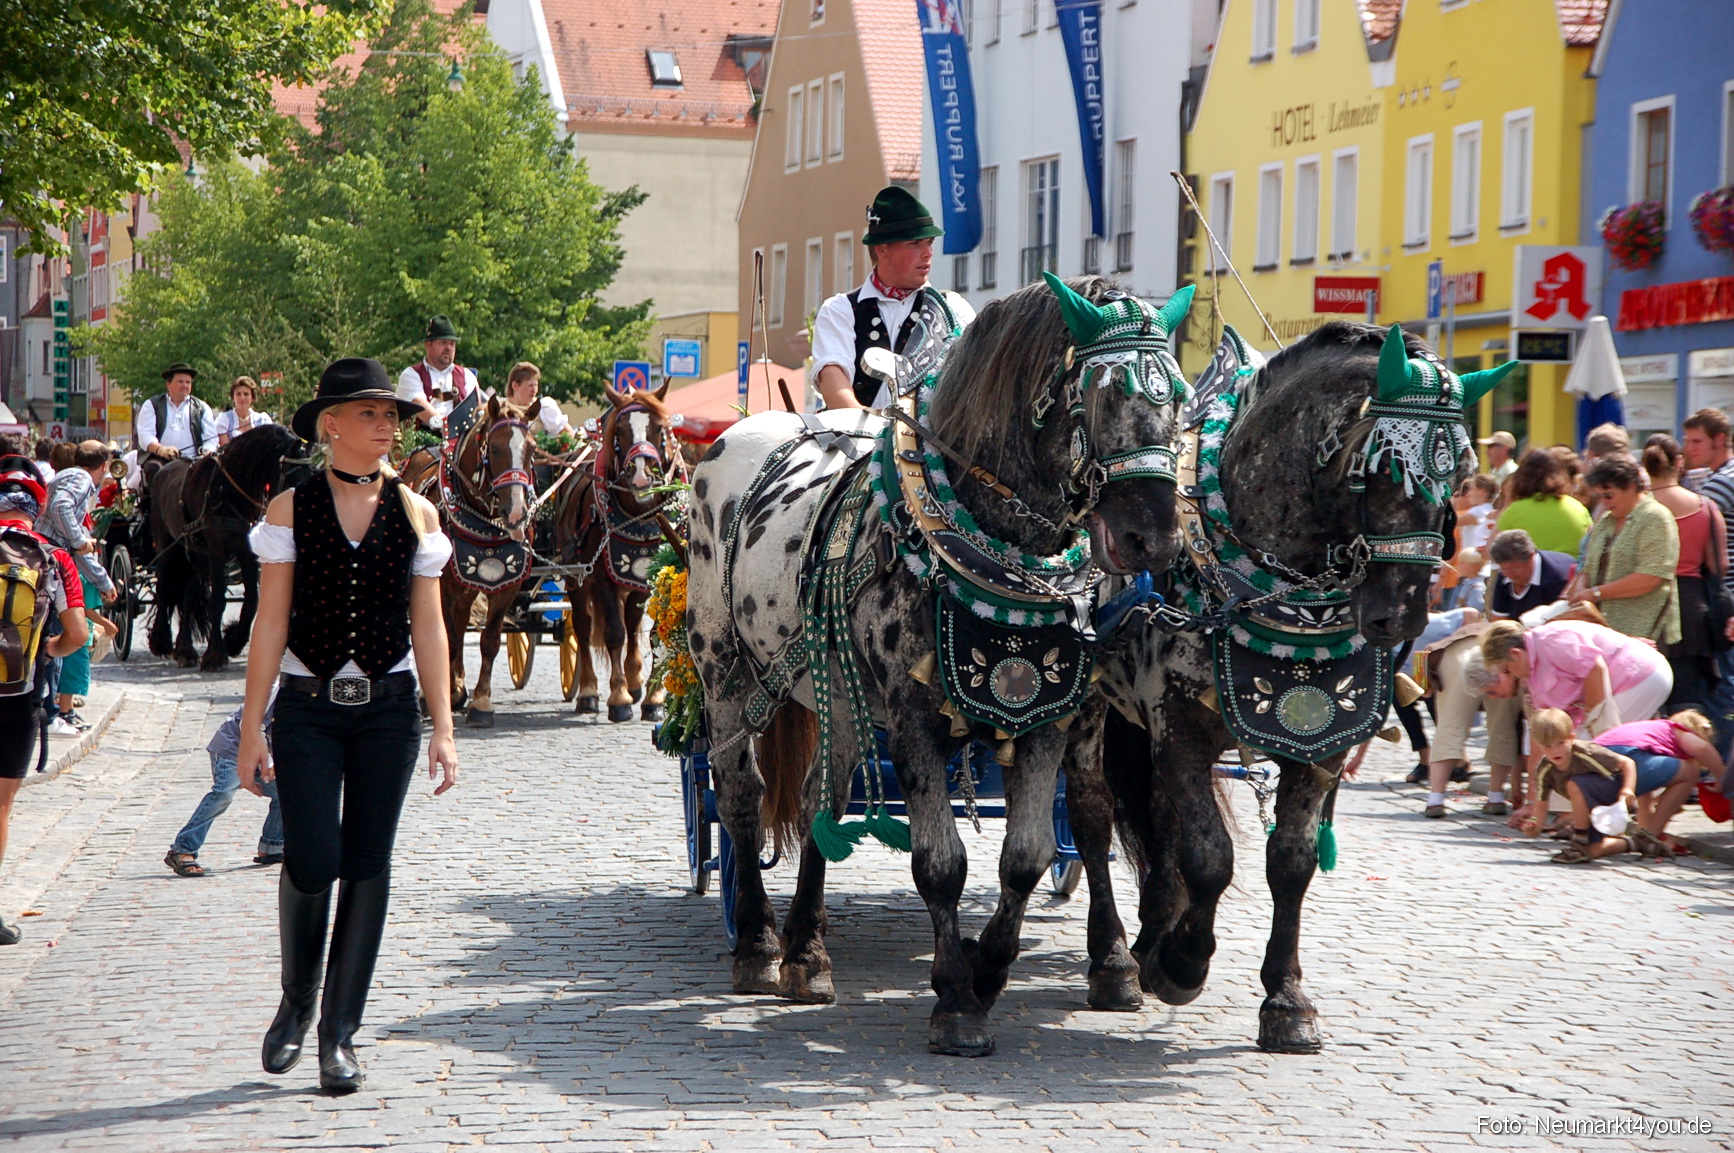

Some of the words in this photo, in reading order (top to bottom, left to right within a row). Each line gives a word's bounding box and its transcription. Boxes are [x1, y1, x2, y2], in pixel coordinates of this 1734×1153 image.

[1272, 103, 1317, 147] HOTEL
[1317, 288, 1377, 302] WISSMAC
[55, 301, 67, 419] APOTHEKE
